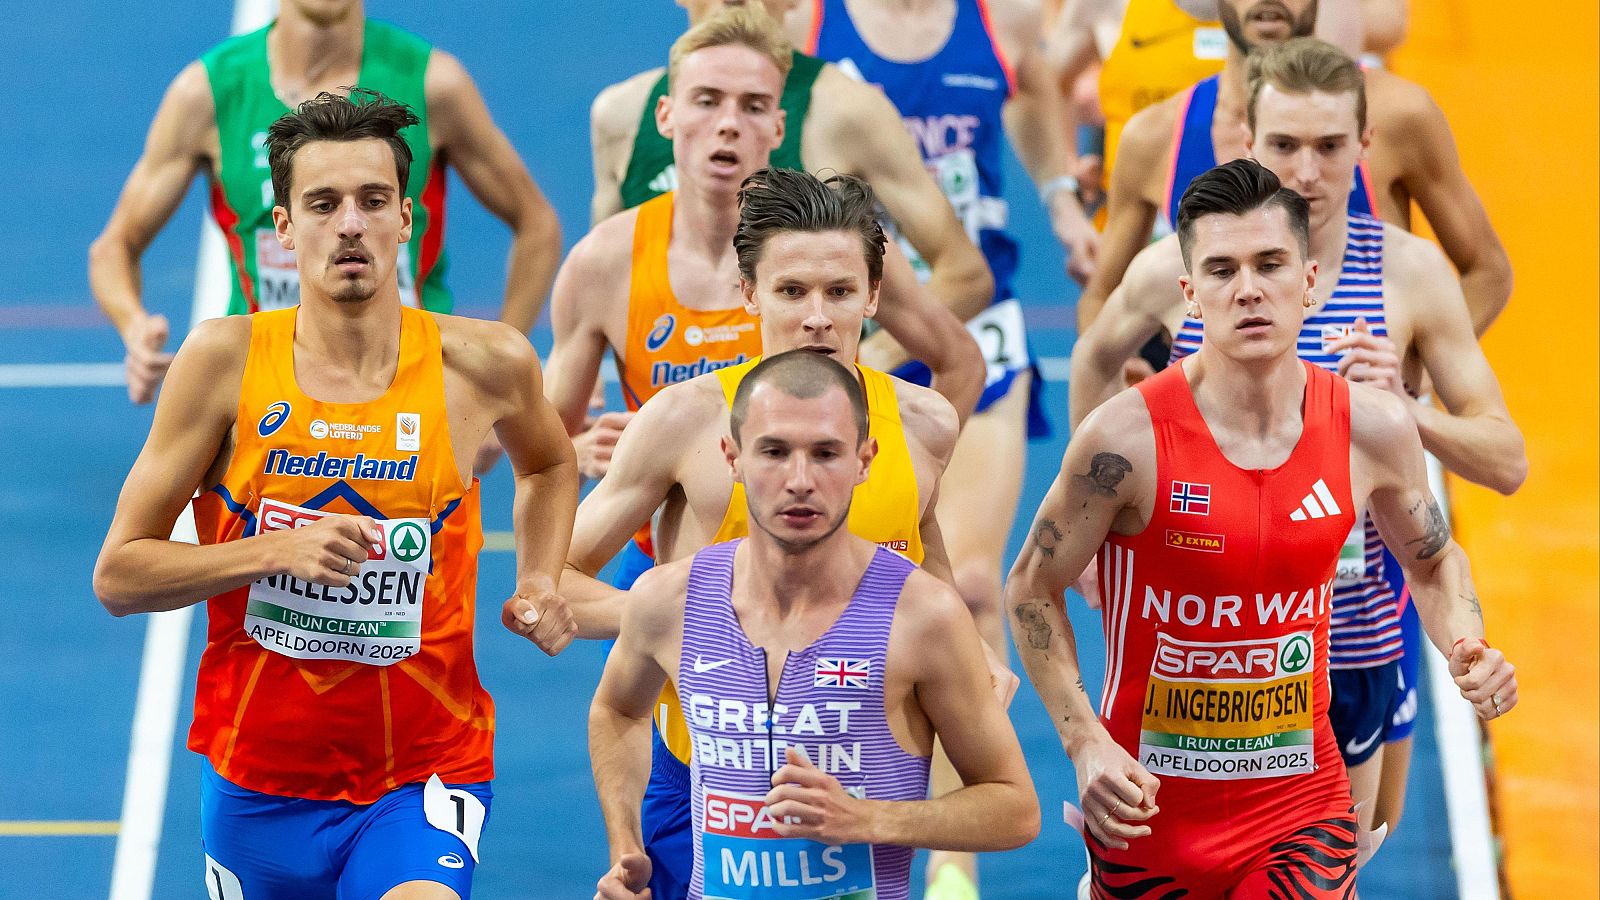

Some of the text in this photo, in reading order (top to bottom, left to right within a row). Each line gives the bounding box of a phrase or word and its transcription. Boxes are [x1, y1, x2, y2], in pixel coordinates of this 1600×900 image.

[329, 422, 381, 433] NEDERLANDSE
[329, 432, 364, 441] LOTERIJ
[1186, 536, 1220, 548] EXTRA
[1142, 578, 1333, 628] NORWAY
[282, 609, 287, 622] I
[289, 611, 323, 631] RUN
[251, 624, 414, 659] APELDOORN 2025
[1157, 645, 1275, 675] SPAR
[690, 693, 861, 736] GREAT
[1145, 680, 1308, 723] J. INGEBRIGTSEN
[1178, 735, 1184, 748] I
[1186, 736, 1221, 750] RUN
[1146, 752, 1309, 773] APELDOORN 2025
[450, 794, 465, 836] 1
[706, 800, 801, 834] SPA
[720, 846, 847, 887] MILLS
